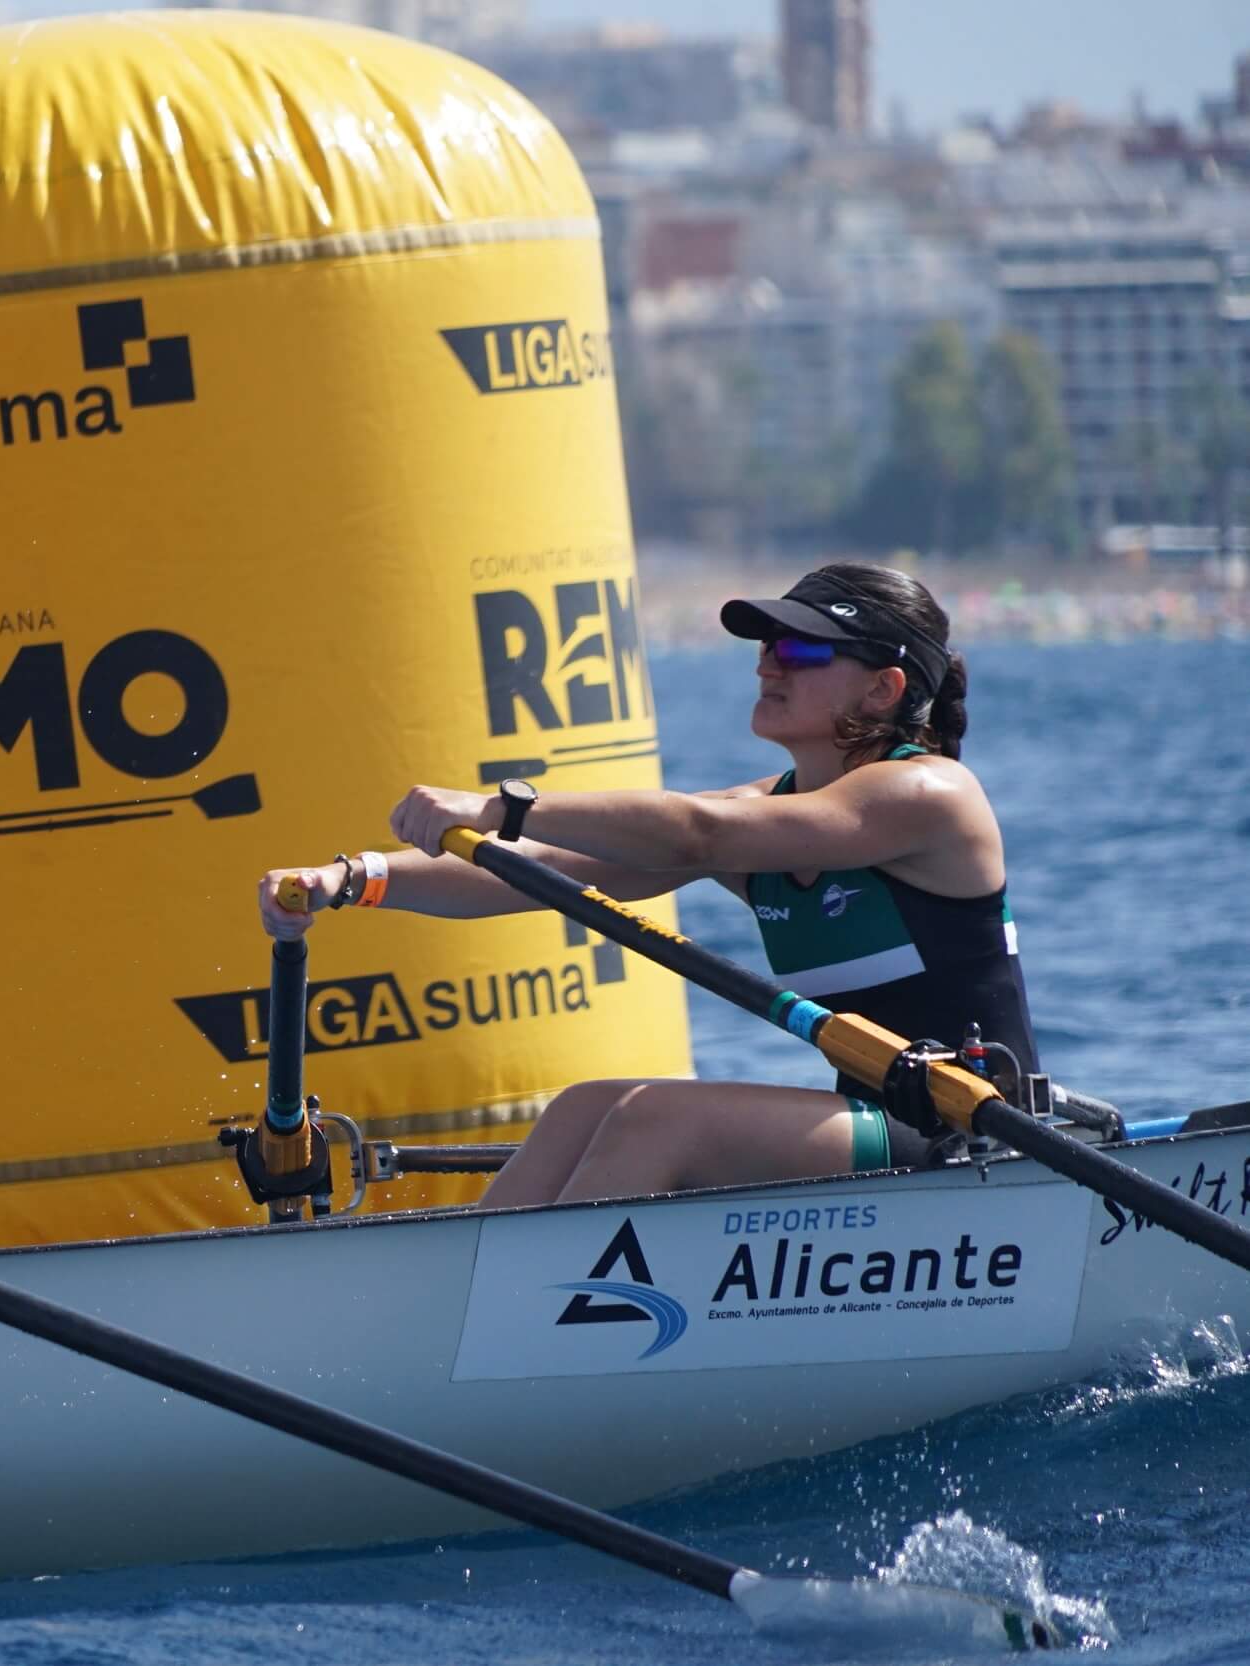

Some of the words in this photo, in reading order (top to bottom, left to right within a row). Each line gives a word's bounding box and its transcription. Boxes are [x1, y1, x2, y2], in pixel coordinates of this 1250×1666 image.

[483, 323, 583, 391] LIGA
[472, 577, 653, 737] REM
[240, 980, 414, 1055] LGA
[422, 962, 591, 1033] suma
[723, 1204, 878, 1236] DEPORTES
[710, 1234, 1023, 1303] Alicante
[707, 1309, 744, 1321] Excmo.
[747, 1305, 820, 1321] Ayuntamiento
[822, 1303, 837, 1315] de
[838, 1301, 882, 1313] Alicante
[950, 1296, 964, 1308] de
[966, 1295, 1016, 1310] Deportes
